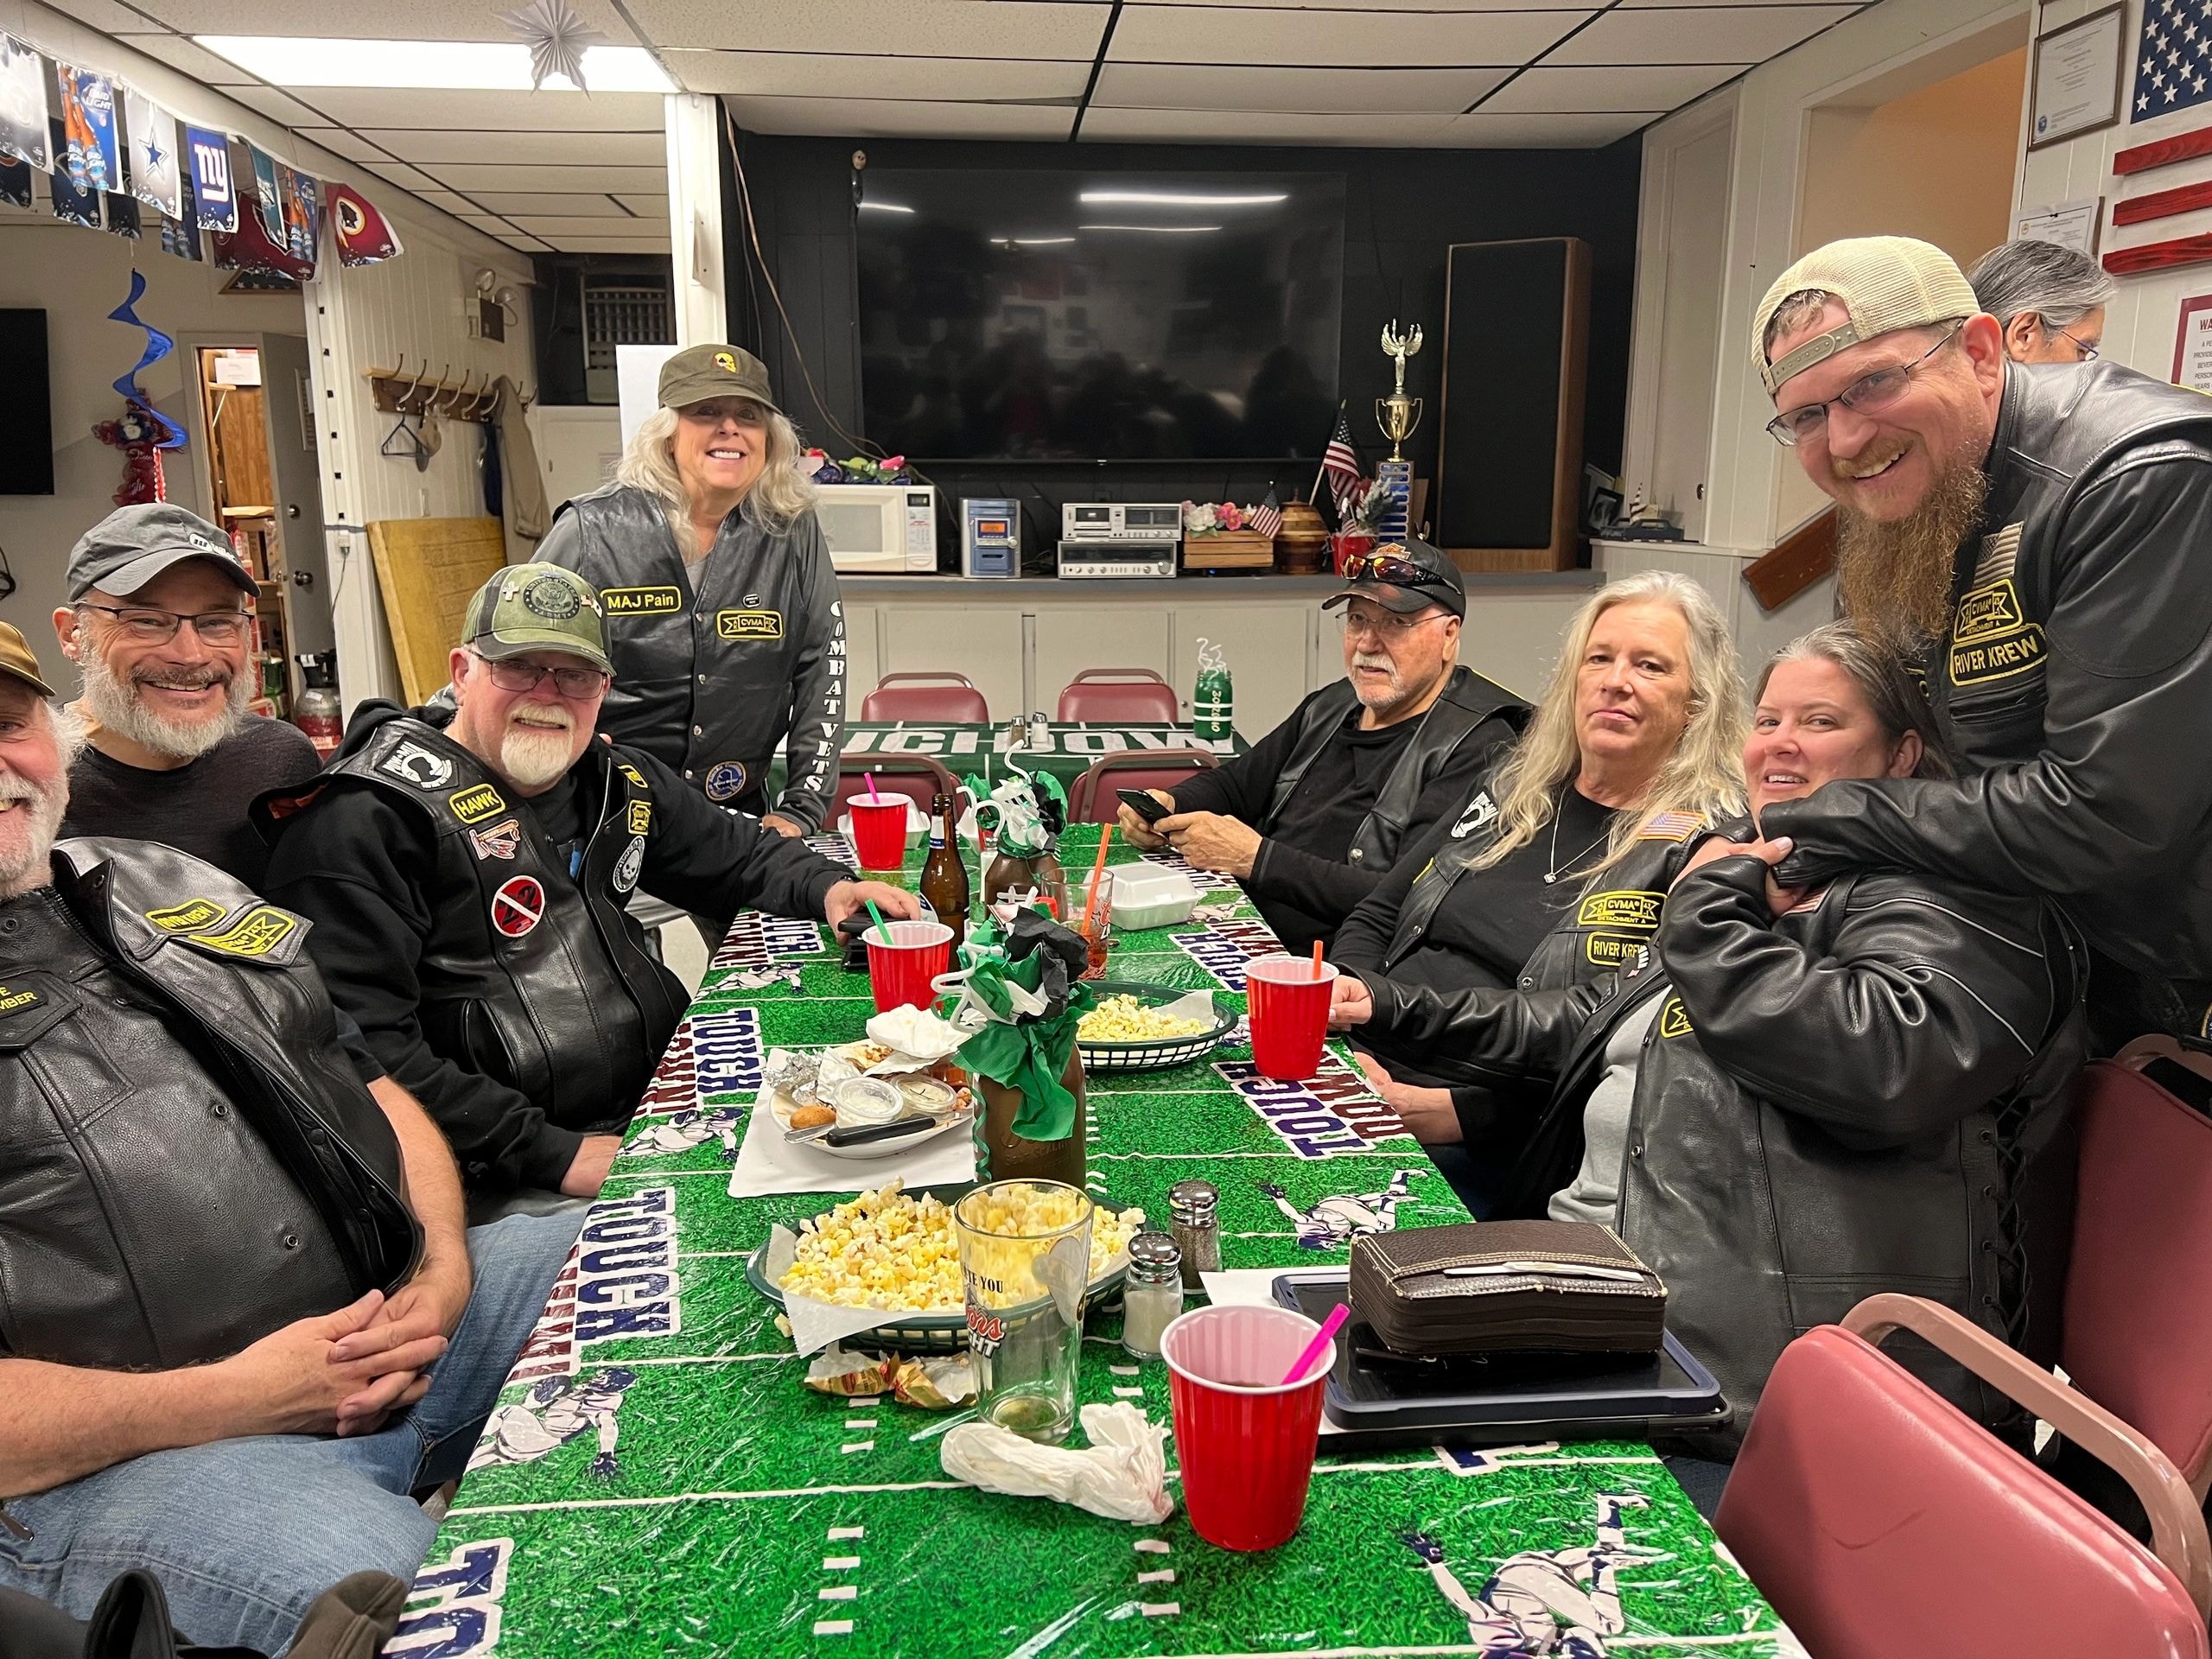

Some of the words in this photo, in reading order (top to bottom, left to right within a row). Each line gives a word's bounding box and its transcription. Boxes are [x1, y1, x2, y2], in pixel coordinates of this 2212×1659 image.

[86, 97, 112, 111] LIGHT
[607, 594, 641, 608] MAJ
[645, 593, 674, 607] Pain
[824, 601, 846, 715] COMBAT
[1955, 649, 1986, 674] RIVER
[1987, 634, 2038, 668] KREW
[455, 791, 499, 817] HAWK
[1593, 940, 1620, 957] RIVER
[1621, 943, 1643, 958] KRE
[691, 1009, 762, 1093] TOUCH
[575, 1190, 671, 1341] TOUCH
[980, 1275, 1003, 1293] YOU
